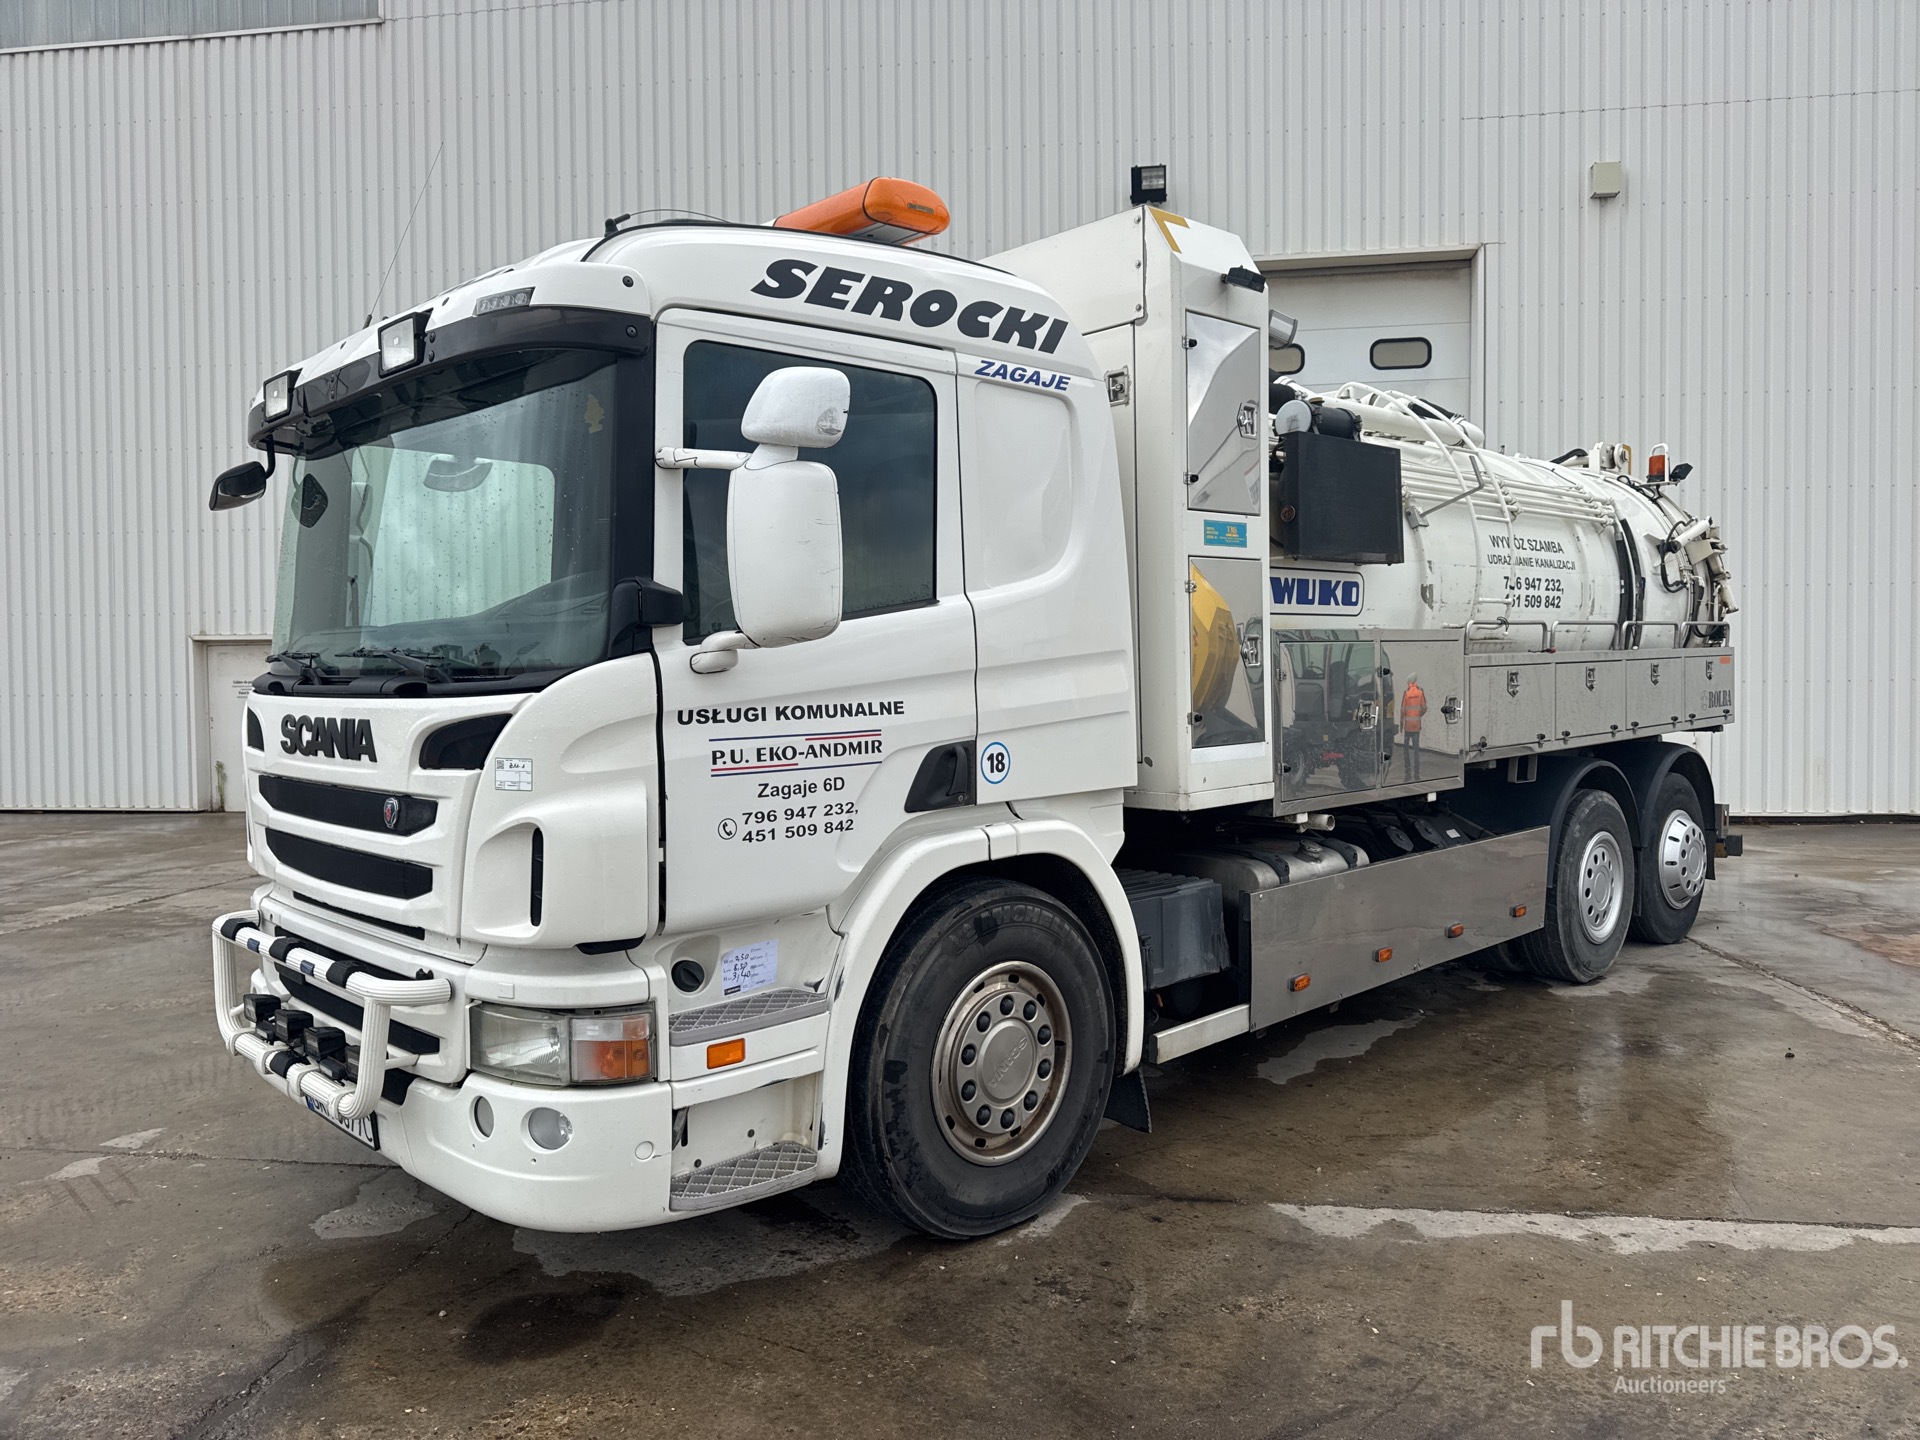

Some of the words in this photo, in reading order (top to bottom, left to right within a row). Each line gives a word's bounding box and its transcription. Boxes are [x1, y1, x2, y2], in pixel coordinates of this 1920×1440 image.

[750, 258, 1069, 354] SEROCKI
[974, 360, 1072, 392] ZAGAJE
[1527, 539, 1565, 554] SZAMBA
[1534, 558, 1576, 570] KANALIZACJI
[1270, 576, 1360, 607] WUKO
[1503, 576, 1522, 590] 76
[1524, 577, 1542, 591] 947
[1544, 578, 1564, 595] 232,
[1524, 595, 1542, 608] 509
[1544, 595, 1562, 609] 842
[1708, 689, 1732, 709] ROLBA
[677, 705, 767, 726] USŁUGI
[775, 701, 905, 721] KOMUNALNE
[280, 713, 378, 763] SCANIA
[711, 748, 750, 766] P.U.
[756, 739, 883, 763] EKO-ANDMIR
[986, 752, 1006, 774] 18
[757, 778, 818, 800] Zagaje
[823, 777, 846, 793] 6D
[742, 809, 778, 825] 796
[784, 805, 817, 821] 947
[823, 801, 859, 817] 232,
[742, 827, 777, 843] 451
[784, 824, 818, 838] 509
[823, 818, 854, 834] 842
[987, 1036, 1028, 1088] SCANIA
